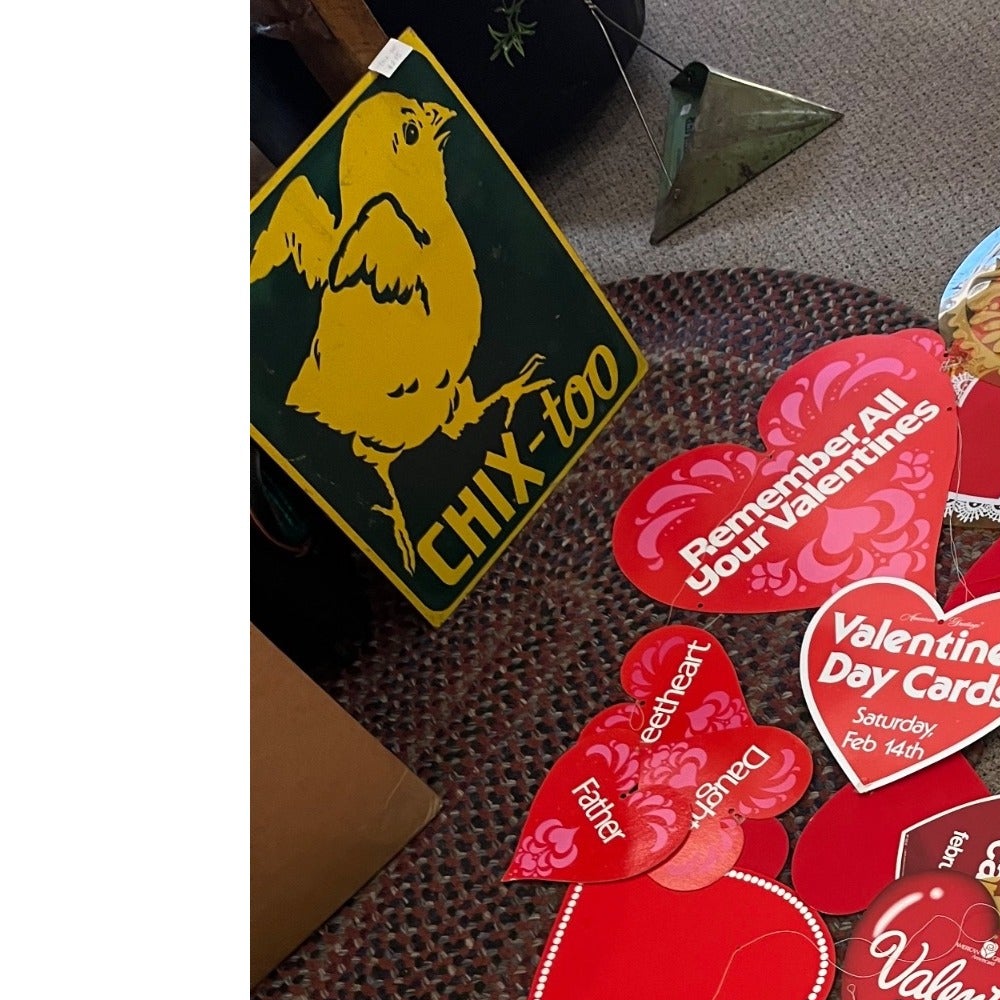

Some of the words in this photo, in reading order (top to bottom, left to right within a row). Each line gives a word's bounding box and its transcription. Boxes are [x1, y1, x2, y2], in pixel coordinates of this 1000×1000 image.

[678, 423, 861, 569] Remember
[857, 388, 909, 434] All
[684, 525, 770, 597] your
[762, 400, 940, 531] Valentines
[640, 640, 712, 744] eetheart
[817, 651, 899, 699] Day
[841, 731, 877, 753] Feb
[885, 739, 925, 761] 14th
[852, 706, 939, 740] Saturday,
[571, 777, 626, 844] Father
[689, 744, 771, 830] Daught
